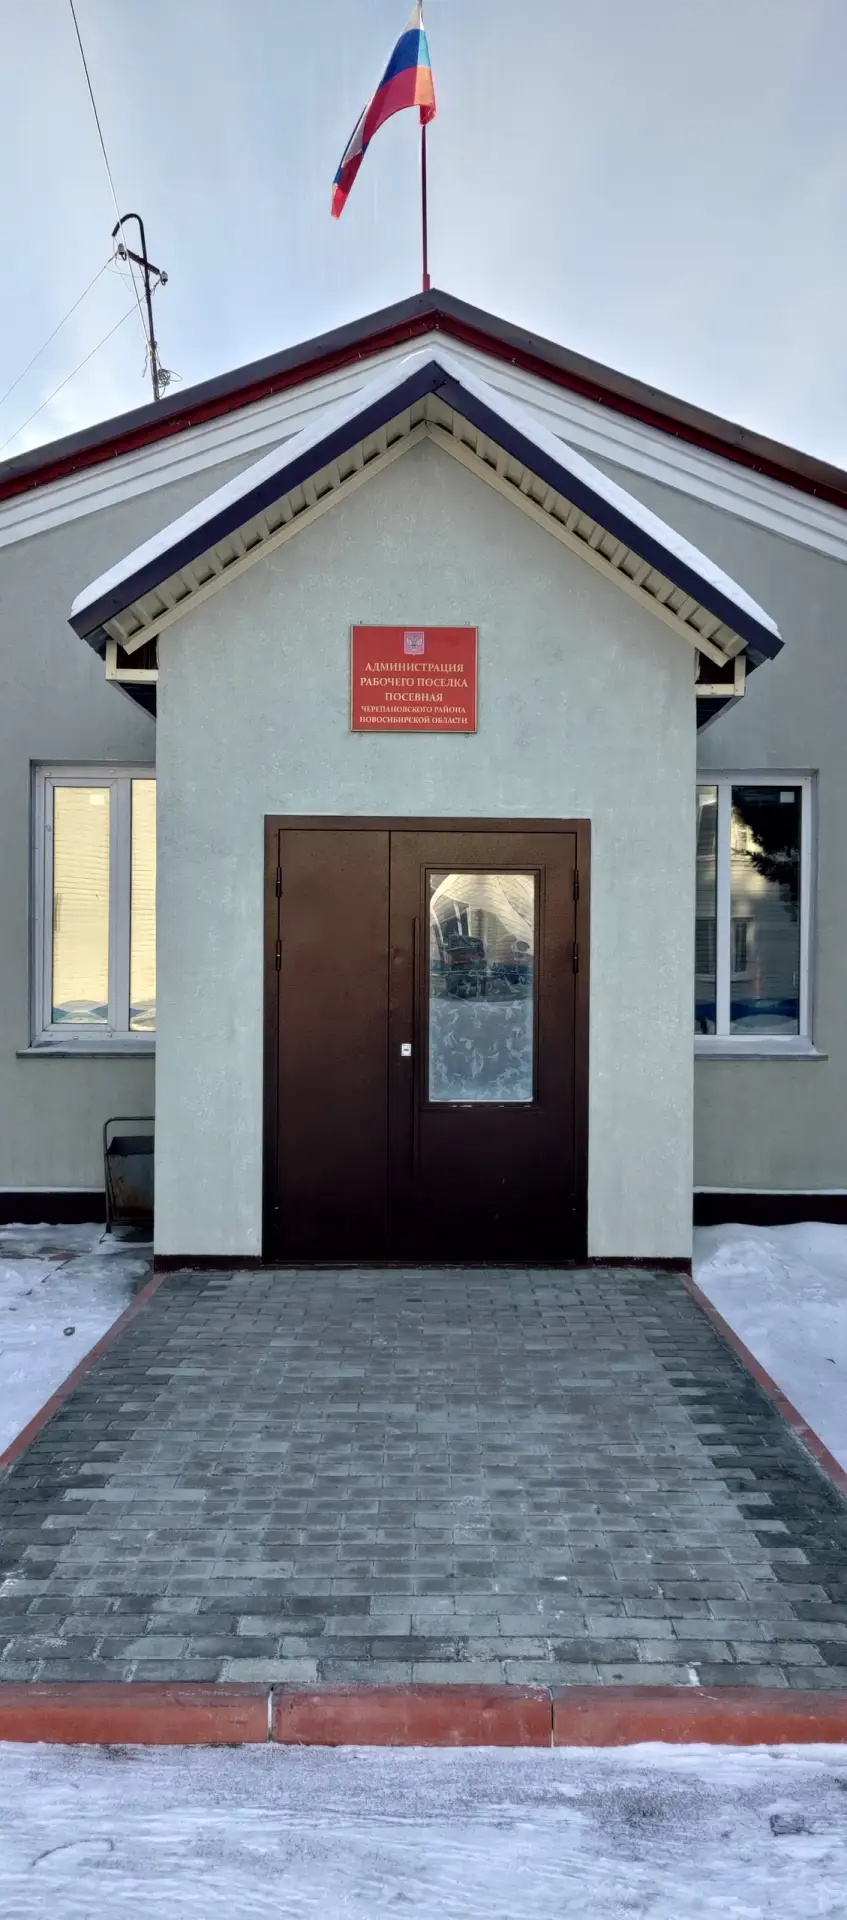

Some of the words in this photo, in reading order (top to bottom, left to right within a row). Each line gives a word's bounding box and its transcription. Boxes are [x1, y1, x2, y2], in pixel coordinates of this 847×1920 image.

[365, 662, 464, 674] АДМИНИСТРАЦИЯ
[360, 677, 415, 687] РАБОЧЕГО
[417, 678, 468, 687] ПОСЕЛКА
[385, 692, 443, 702] ПОСЕВНАЯ
[361, 705, 433, 713] ЧЕРЕПАНОВСКОГО
[434, 705, 466, 714] РАЙОНА
[360, 715, 430, 724] НОВОСИБИРСКОЙ
